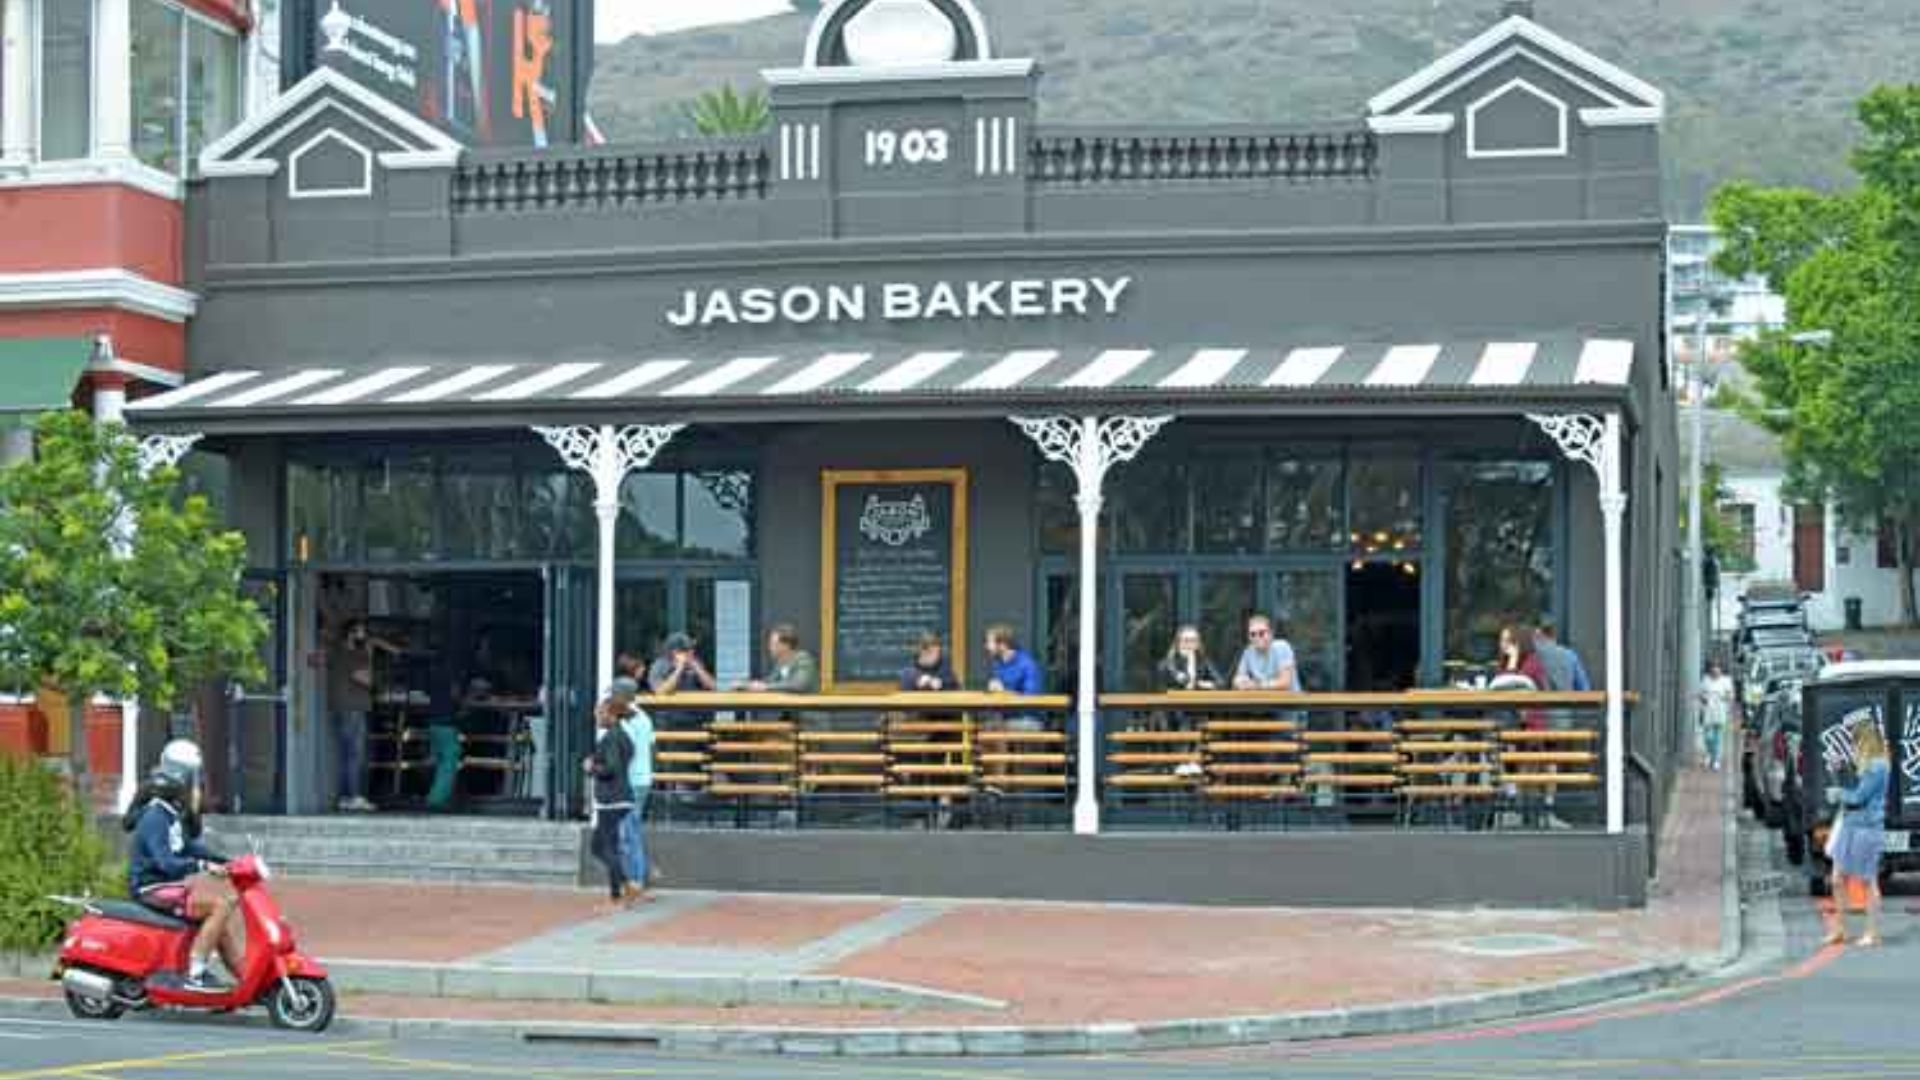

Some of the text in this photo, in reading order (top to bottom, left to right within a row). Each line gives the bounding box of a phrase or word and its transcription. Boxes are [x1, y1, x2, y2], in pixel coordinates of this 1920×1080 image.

[865, 128, 948, 164] 1903
[666, 276, 1131, 326] JASON BAKERY
